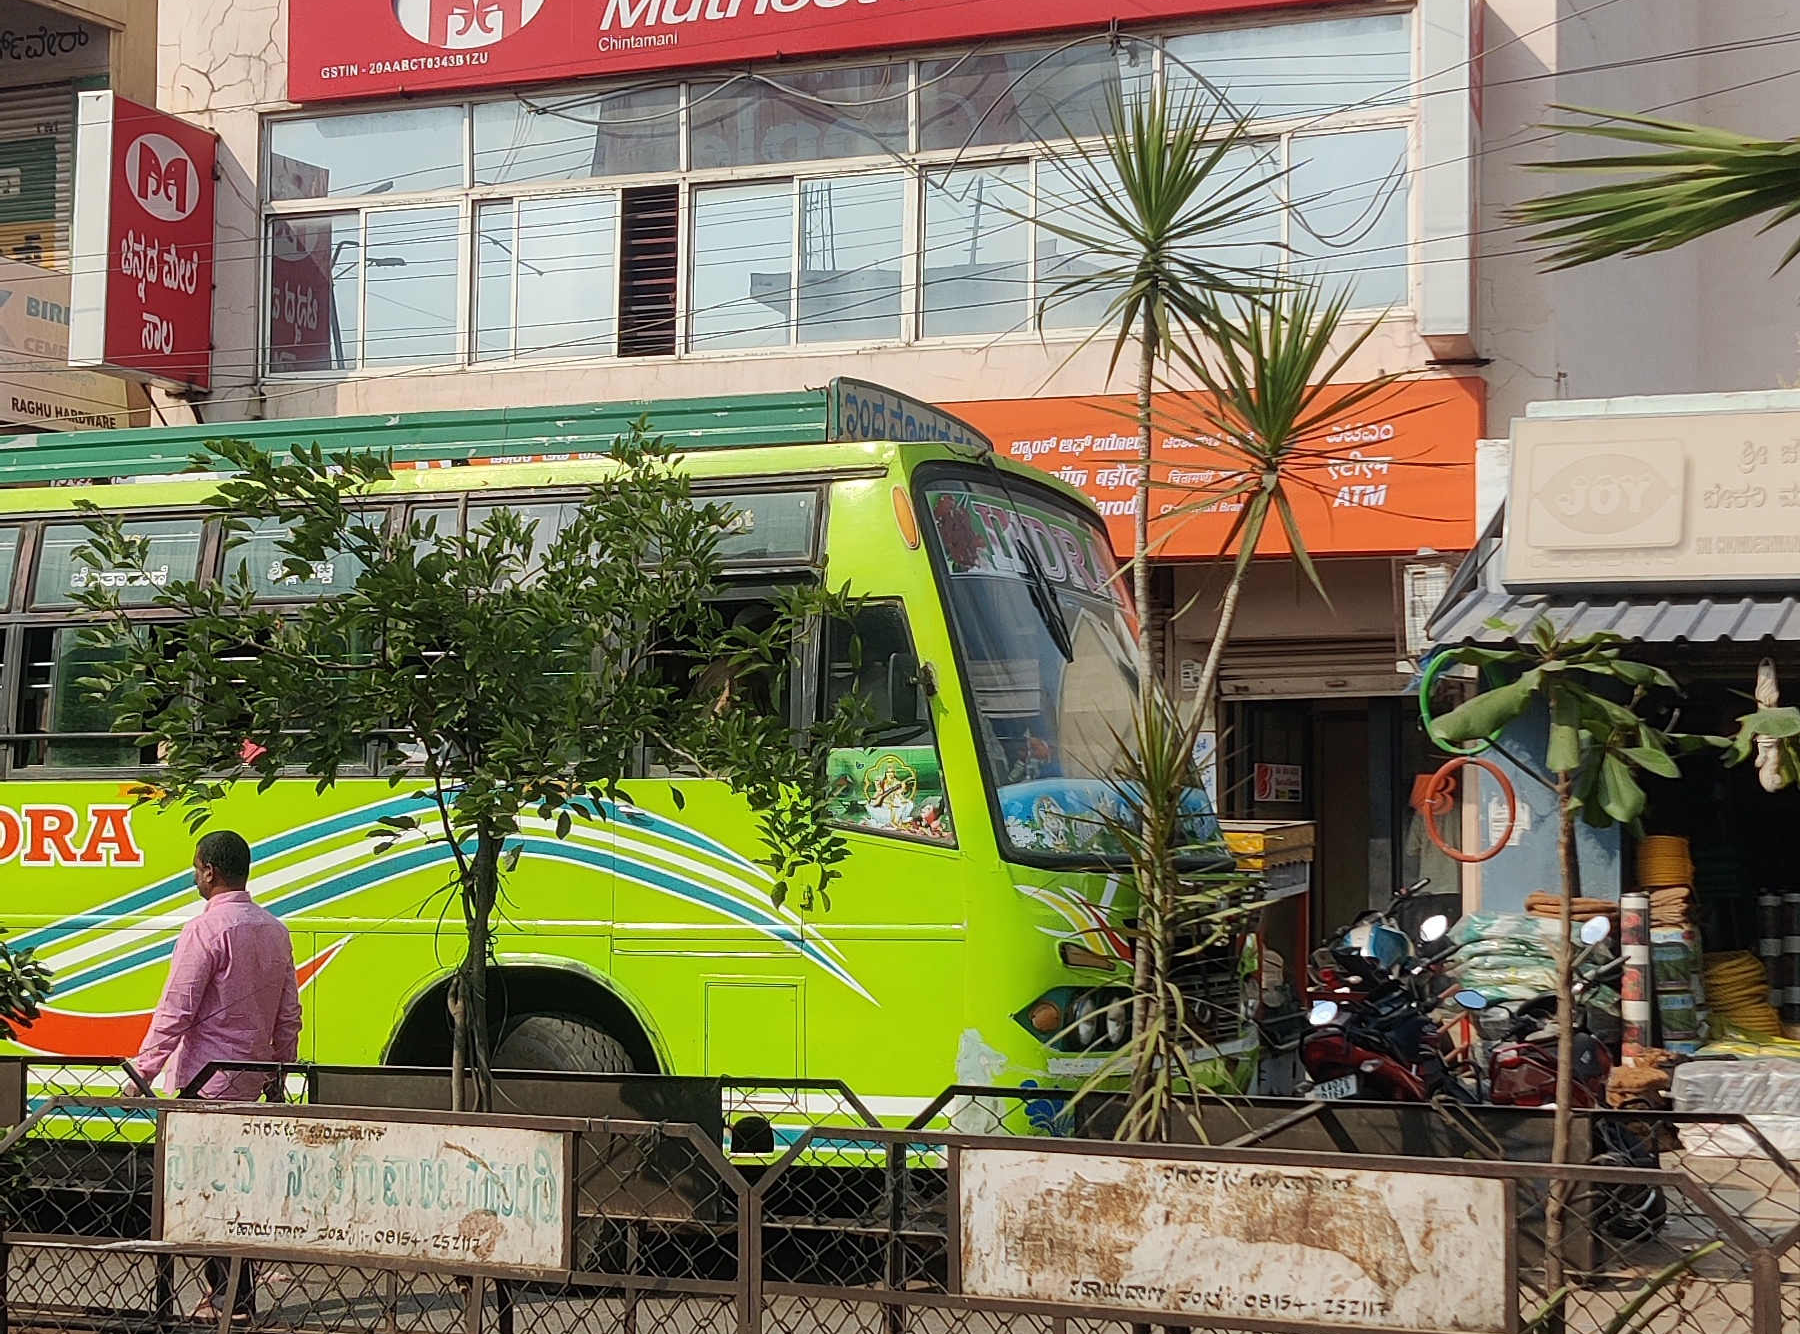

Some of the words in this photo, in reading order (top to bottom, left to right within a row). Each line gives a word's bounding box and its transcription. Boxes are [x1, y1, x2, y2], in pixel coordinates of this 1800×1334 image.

[598, 31, 679, 53] Chintamani
[321, 63, 358, 79] GSTIN
[27, 295, 70, 326] BIR
[141, 312, 174, 355] ಸಾಲ
[24, 337, 68, 358] CEME
[11, 396, 52, 418] RAGHU
[55, 405, 117, 430] HARDWARE
[1096, 463, 1140, 491] बड़ौद
[1332, 484, 1388, 507] ATM
[1555, 473, 1653, 516] JOY
[1695, 535, 1712, 555] SRI
